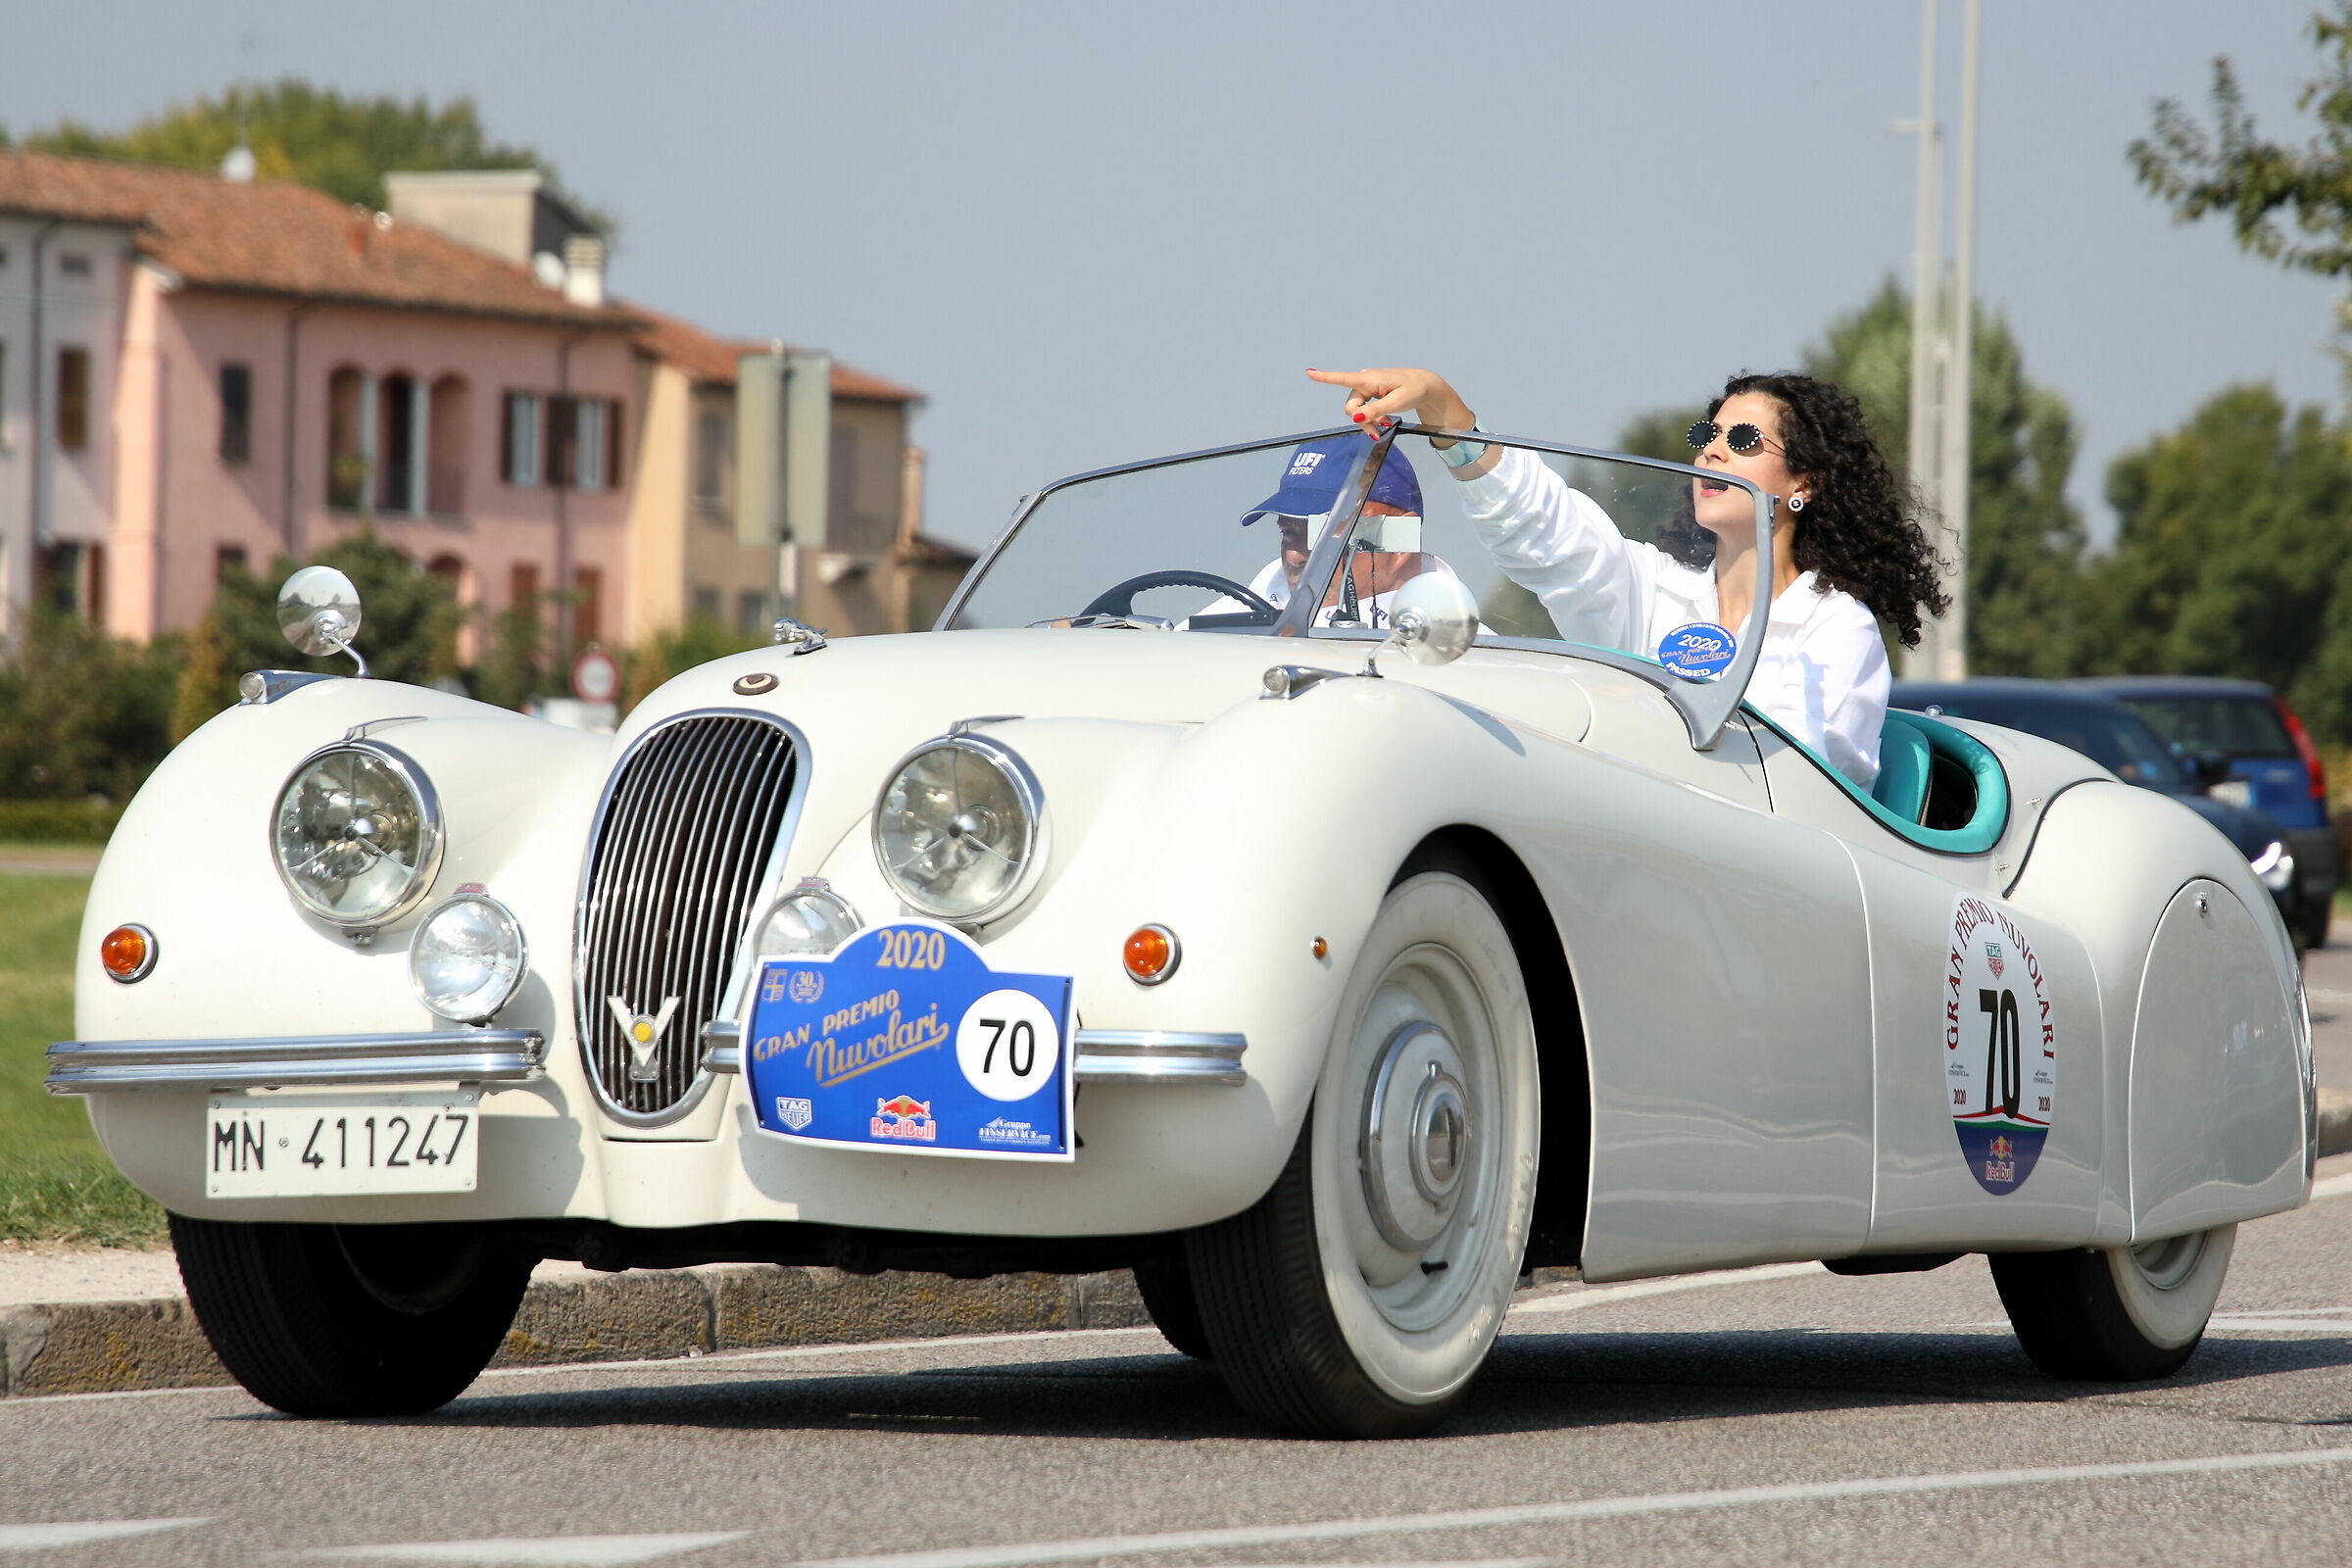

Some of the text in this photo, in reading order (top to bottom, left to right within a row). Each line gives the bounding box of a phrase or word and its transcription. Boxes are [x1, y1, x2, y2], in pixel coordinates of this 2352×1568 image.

[1294, 452, 1325, 466] UFI
[1678, 634, 1722, 651] 2020
[1666, 662, 1711, 676] PASSED
[876, 929, 946, 970] 2020
[1986, 946, 2001, 957] TAG
[1946, 945, 1964, 1051] GRAN
[1955, 898, 1994, 951] PREMIO
[1995, 909, 2055, 1060] NUVOLARI
[754, 990, 900, 1061] GRAN PREMIO
[805, 1004, 950, 1087] Nuvolari
[980, 1018, 1035, 1077] 70
[1980, 989, 2020, 1119] 70
[780, 1099, 808, 1110] TAG
[781, 1111, 809, 1127] HEUER
[215, 1113, 469, 1172] MN 411247
